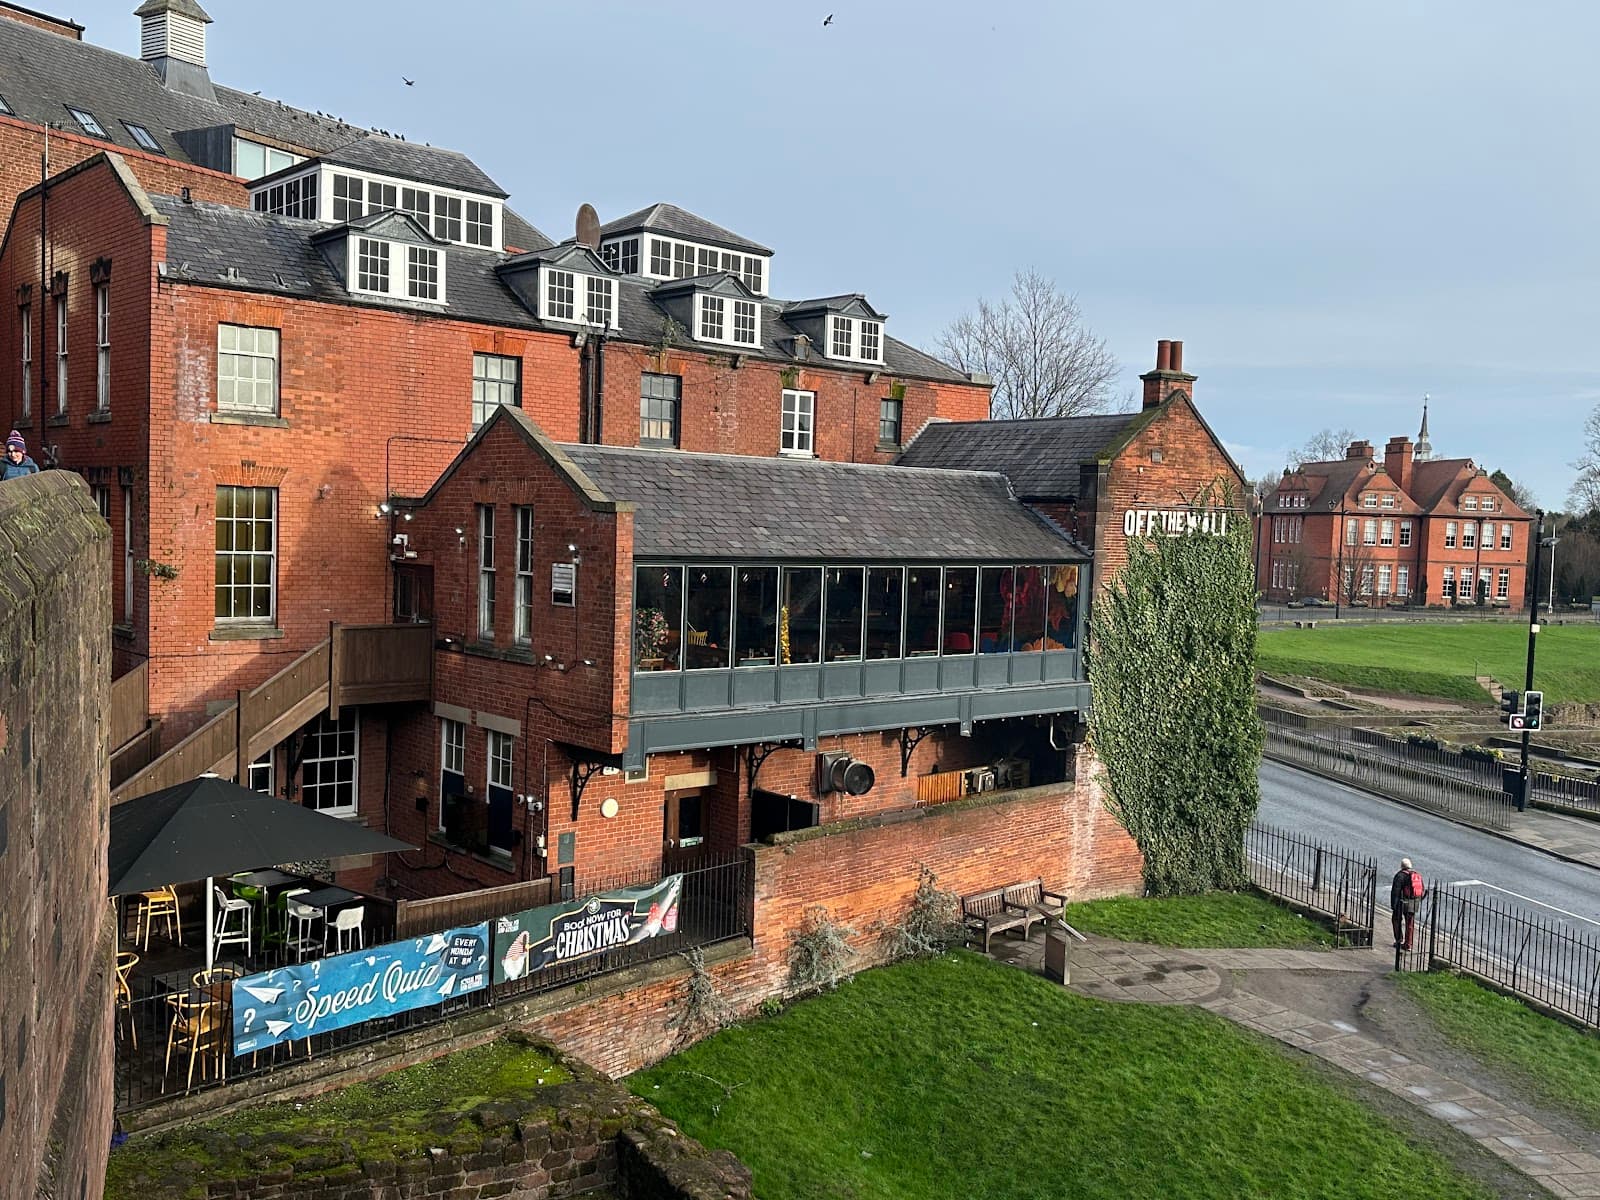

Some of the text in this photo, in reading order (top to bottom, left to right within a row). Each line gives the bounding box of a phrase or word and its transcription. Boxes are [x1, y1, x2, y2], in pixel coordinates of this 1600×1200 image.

[1124, 509, 1158, 537] OFF
[1160, 510, 1185, 532] THE
[586, 913, 606, 925] NOW
[607, 908, 622, 920] FOR
[556, 914, 630, 959] CHRISTMAS
[448, 956, 458, 965] AT
[295, 959, 440, 1029] Speed Quiz
